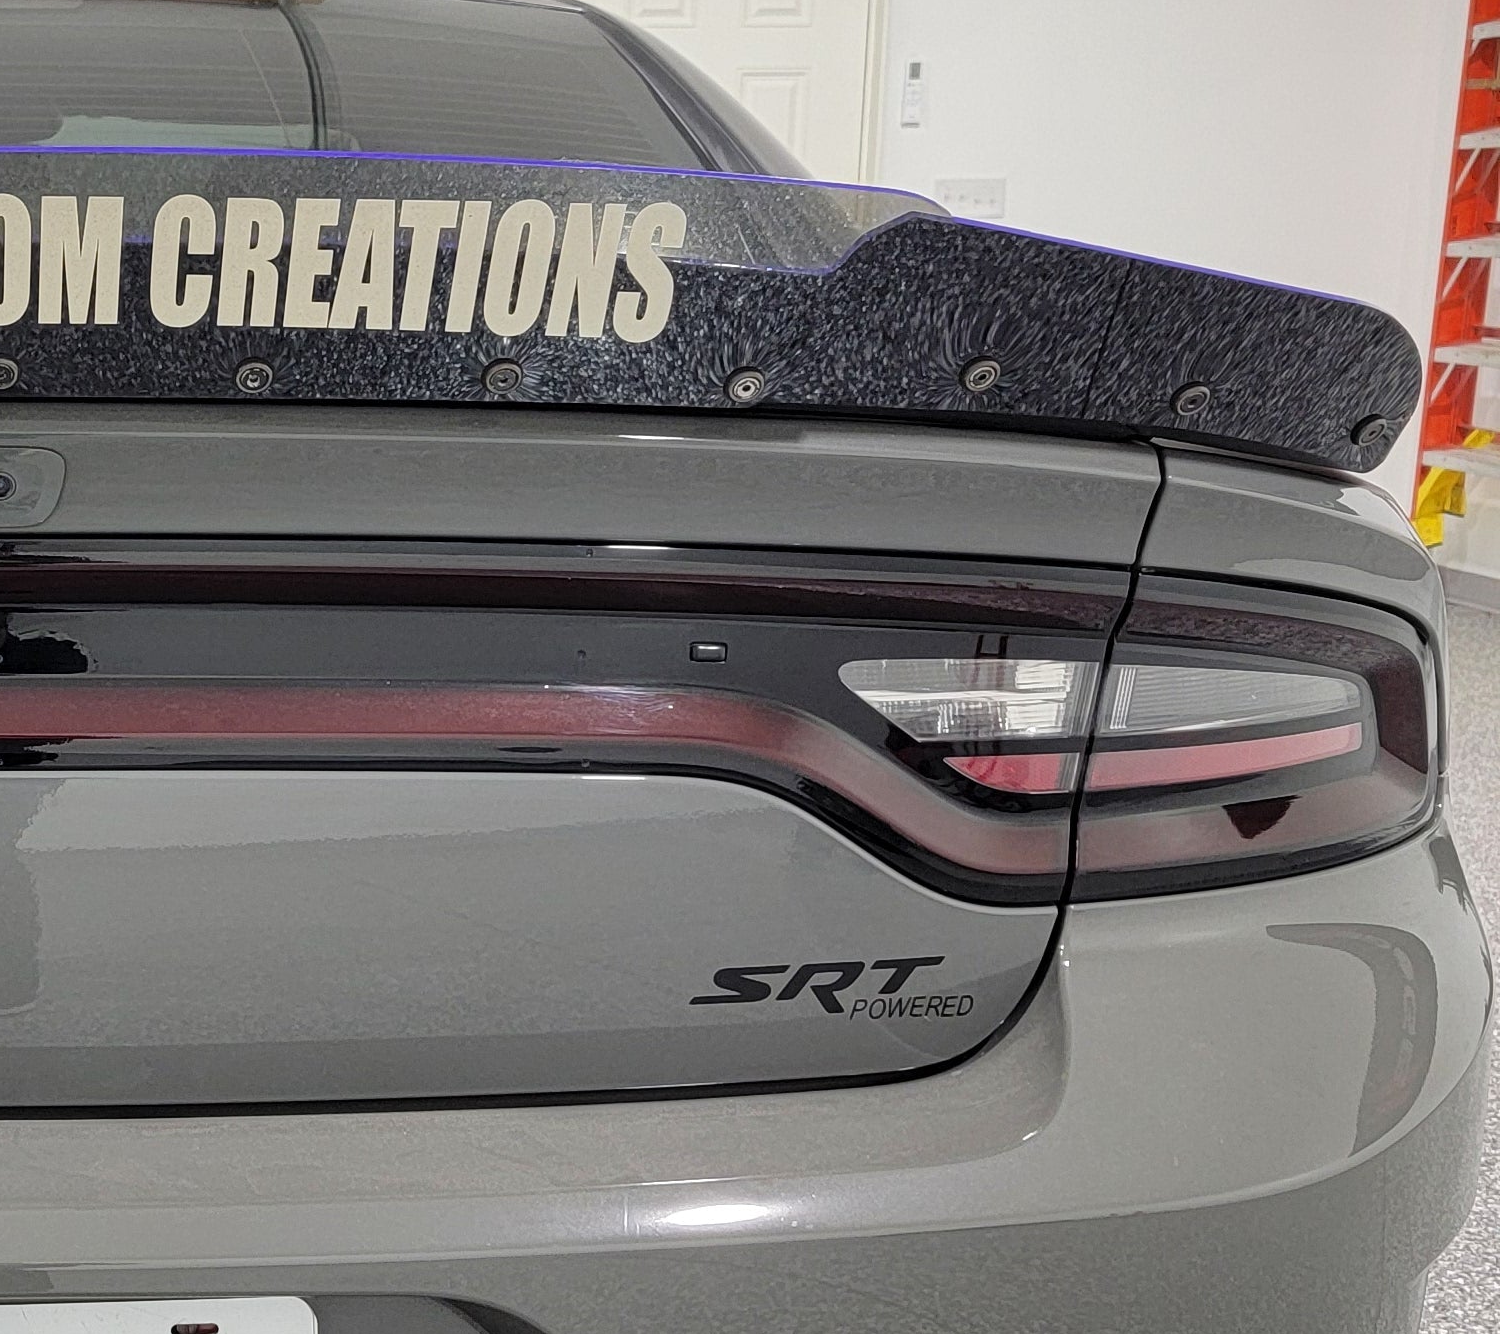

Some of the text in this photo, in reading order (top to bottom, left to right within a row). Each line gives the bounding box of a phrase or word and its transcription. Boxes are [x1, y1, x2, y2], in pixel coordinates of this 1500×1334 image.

[150, 194, 688, 344] CREATIONS
[689, 955, 945, 1014] SRT
[850, 994, 974, 1020] POWERED
